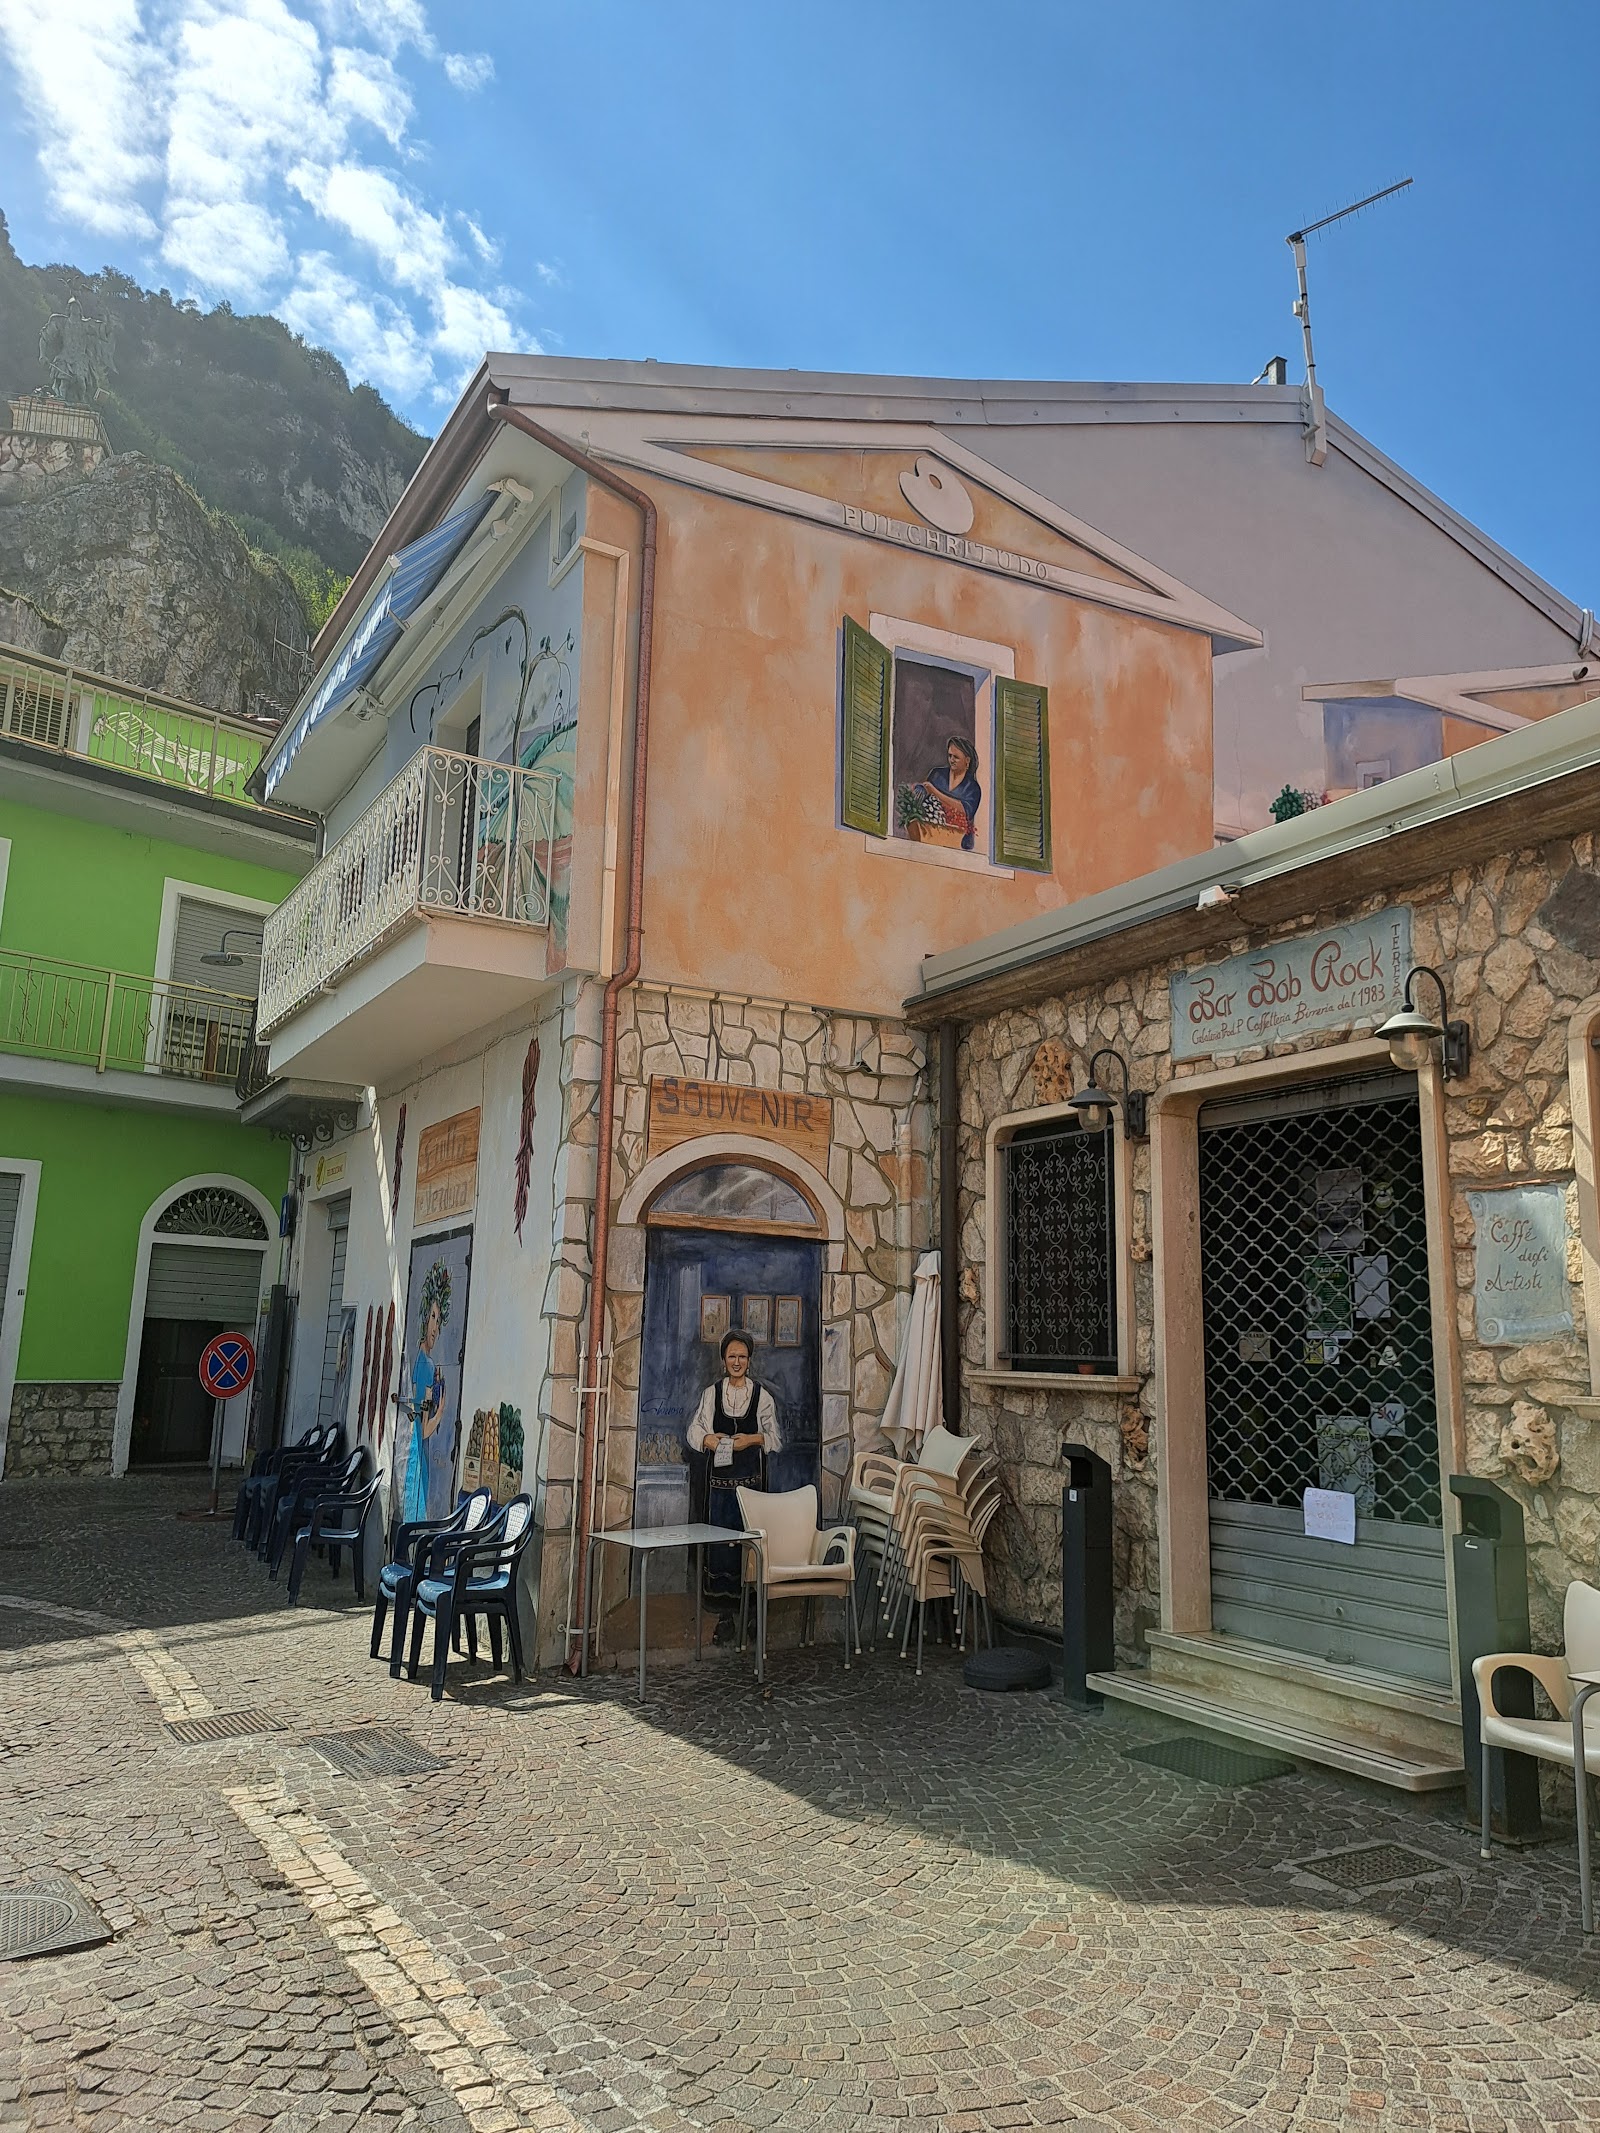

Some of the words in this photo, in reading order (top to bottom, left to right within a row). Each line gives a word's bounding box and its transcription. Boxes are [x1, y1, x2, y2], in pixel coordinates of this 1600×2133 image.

[842, 504, 1047, 580] PULCHRITUDO
[1190, 978, 1237, 1024] Bar
[1248, 959, 1301, 1008] Bob
[1311, 936, 1384, 992] Rock
[1391, 923, 1402, 997] TERESA
[1337, 994, 1356, 1010] dal
[1357, 984, 1386, 1007] 1983
[657, 1078, 814, 1131] SOUVENIR
[1485, 1264, 1543, 1292] Artisti
[1517, 1246, 1549, 1267] degli
